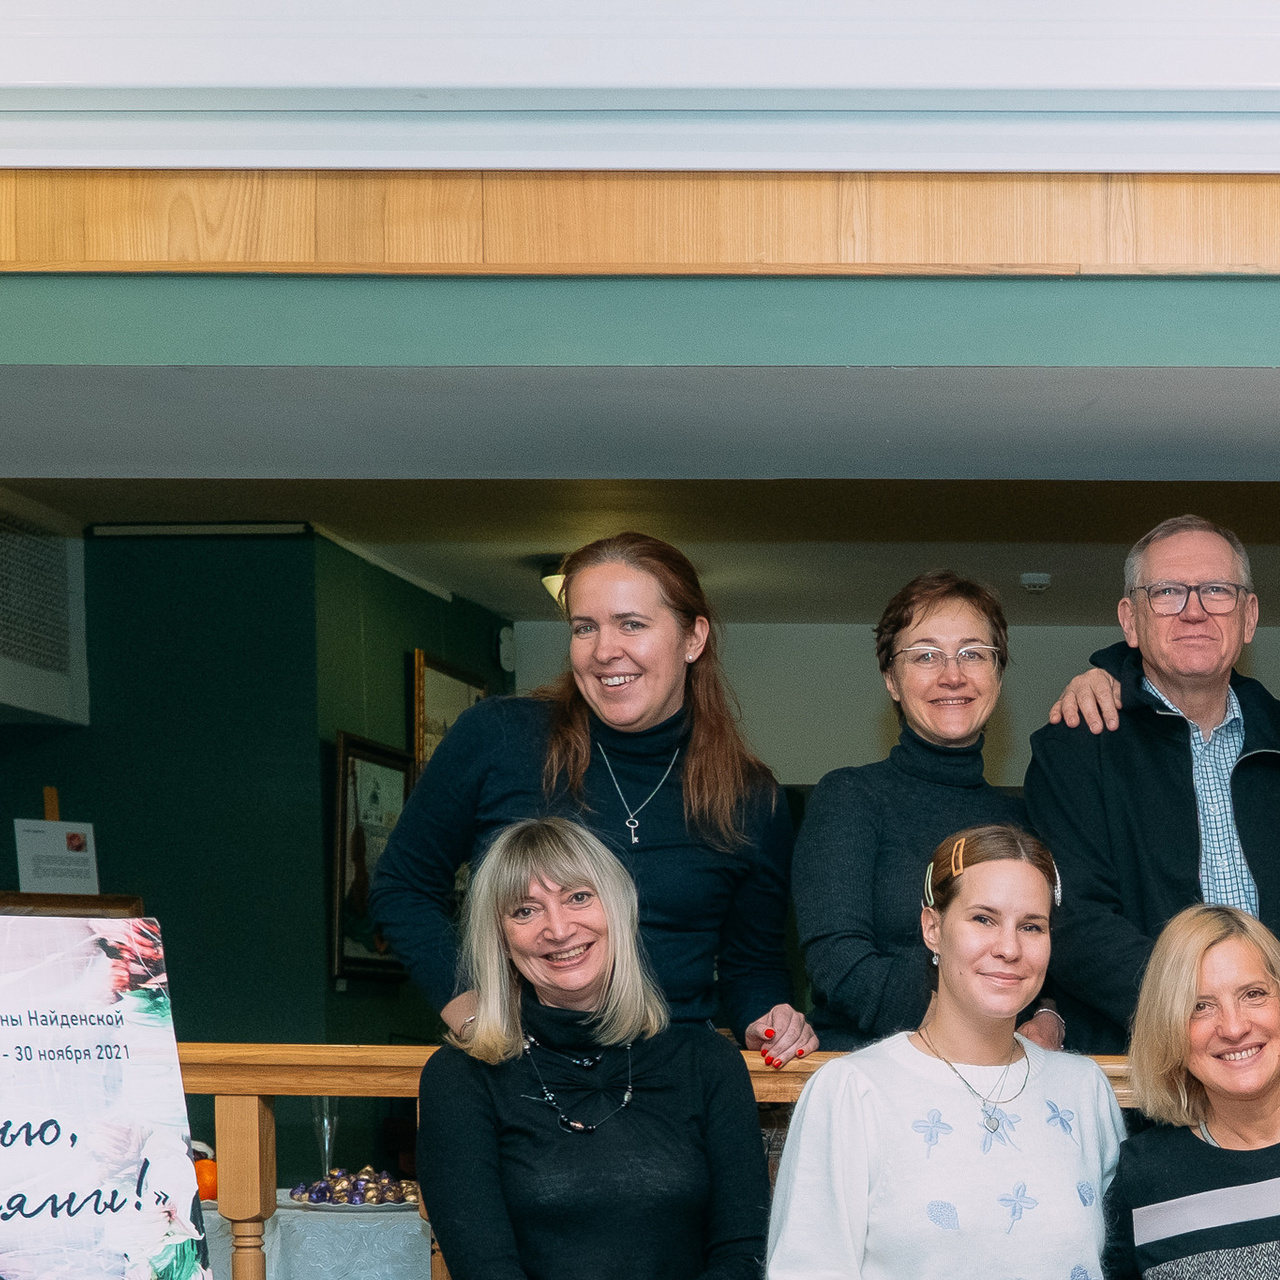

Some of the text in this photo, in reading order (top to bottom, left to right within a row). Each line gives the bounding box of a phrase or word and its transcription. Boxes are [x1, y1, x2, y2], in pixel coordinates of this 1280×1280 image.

[27, 1010, 125, 1029] Найденской
[14, 1045, 33, 1062] 30
[38, 1045, 92, 1064] ноября
[95, 1044, 130, 1060] 2021
